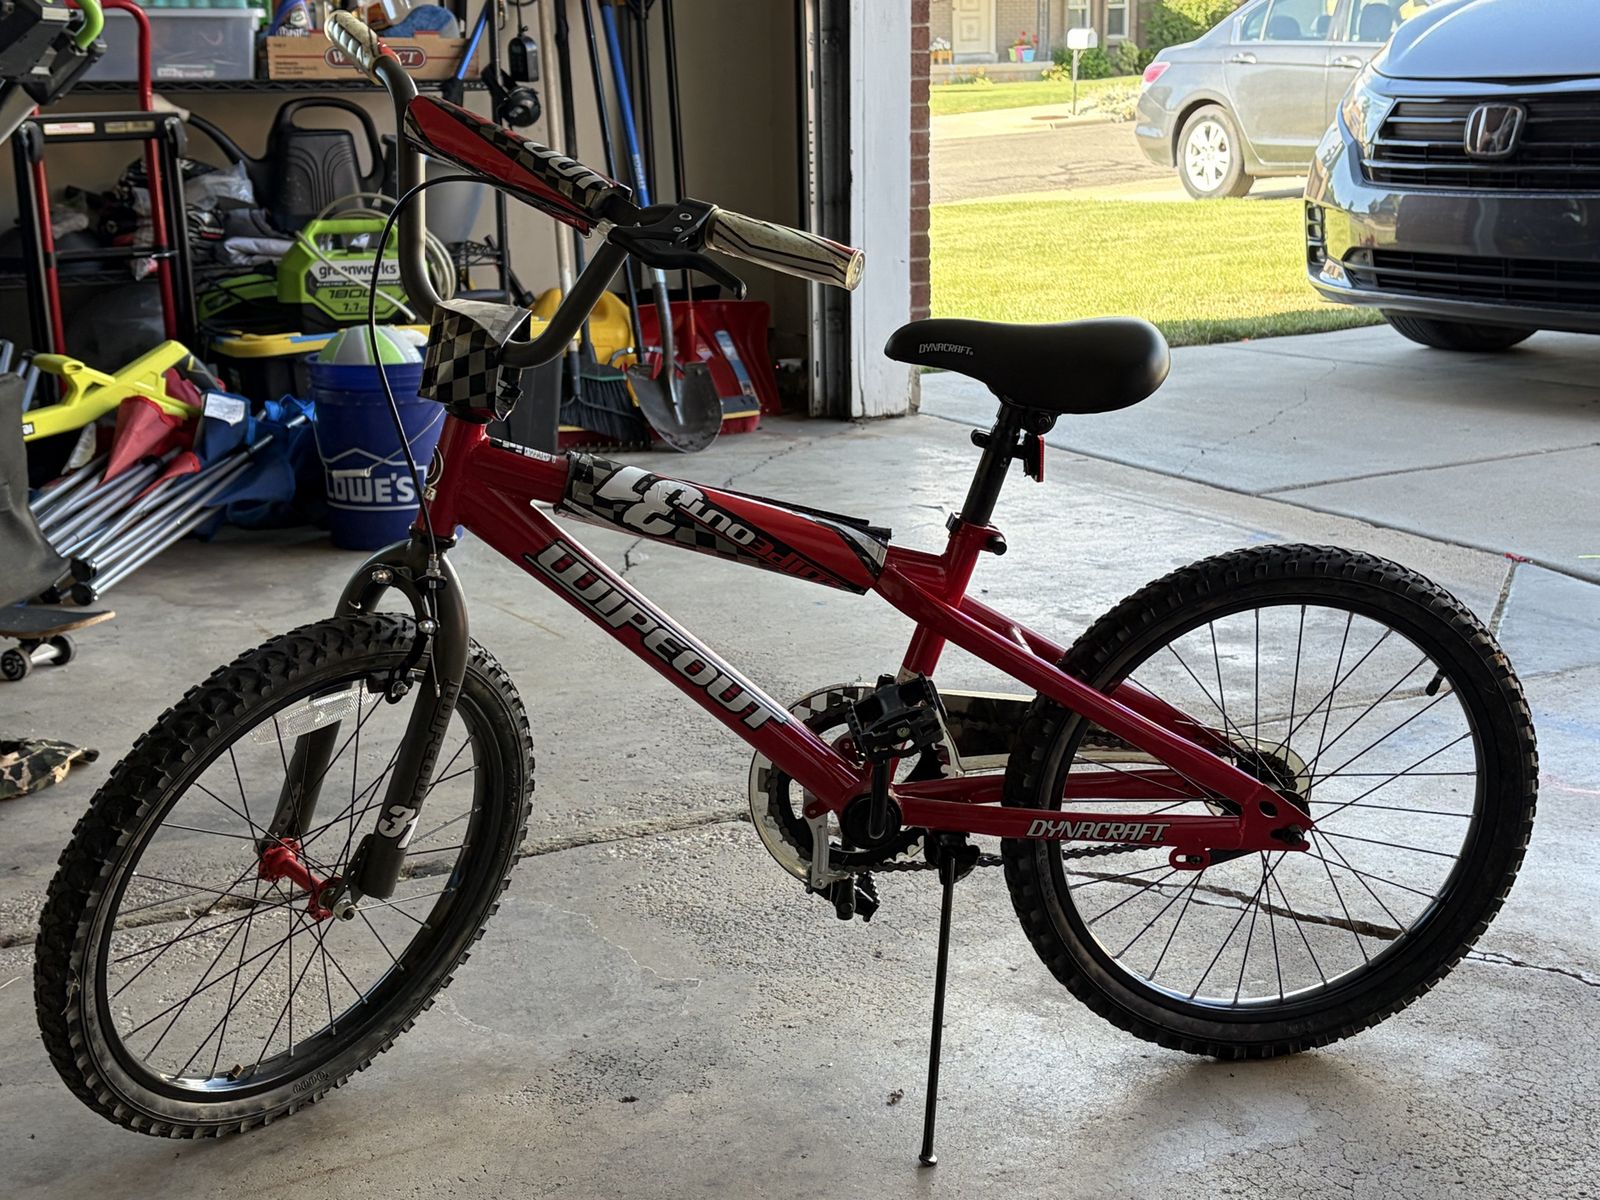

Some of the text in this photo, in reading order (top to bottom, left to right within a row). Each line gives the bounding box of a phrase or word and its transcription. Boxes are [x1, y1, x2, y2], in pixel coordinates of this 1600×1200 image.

[918, 342, 974, 356] DYNACRAFT
[526, 540, 788, 730] WIPEOUT
[1026, 819, 1172, 842] DYNACRAFT
